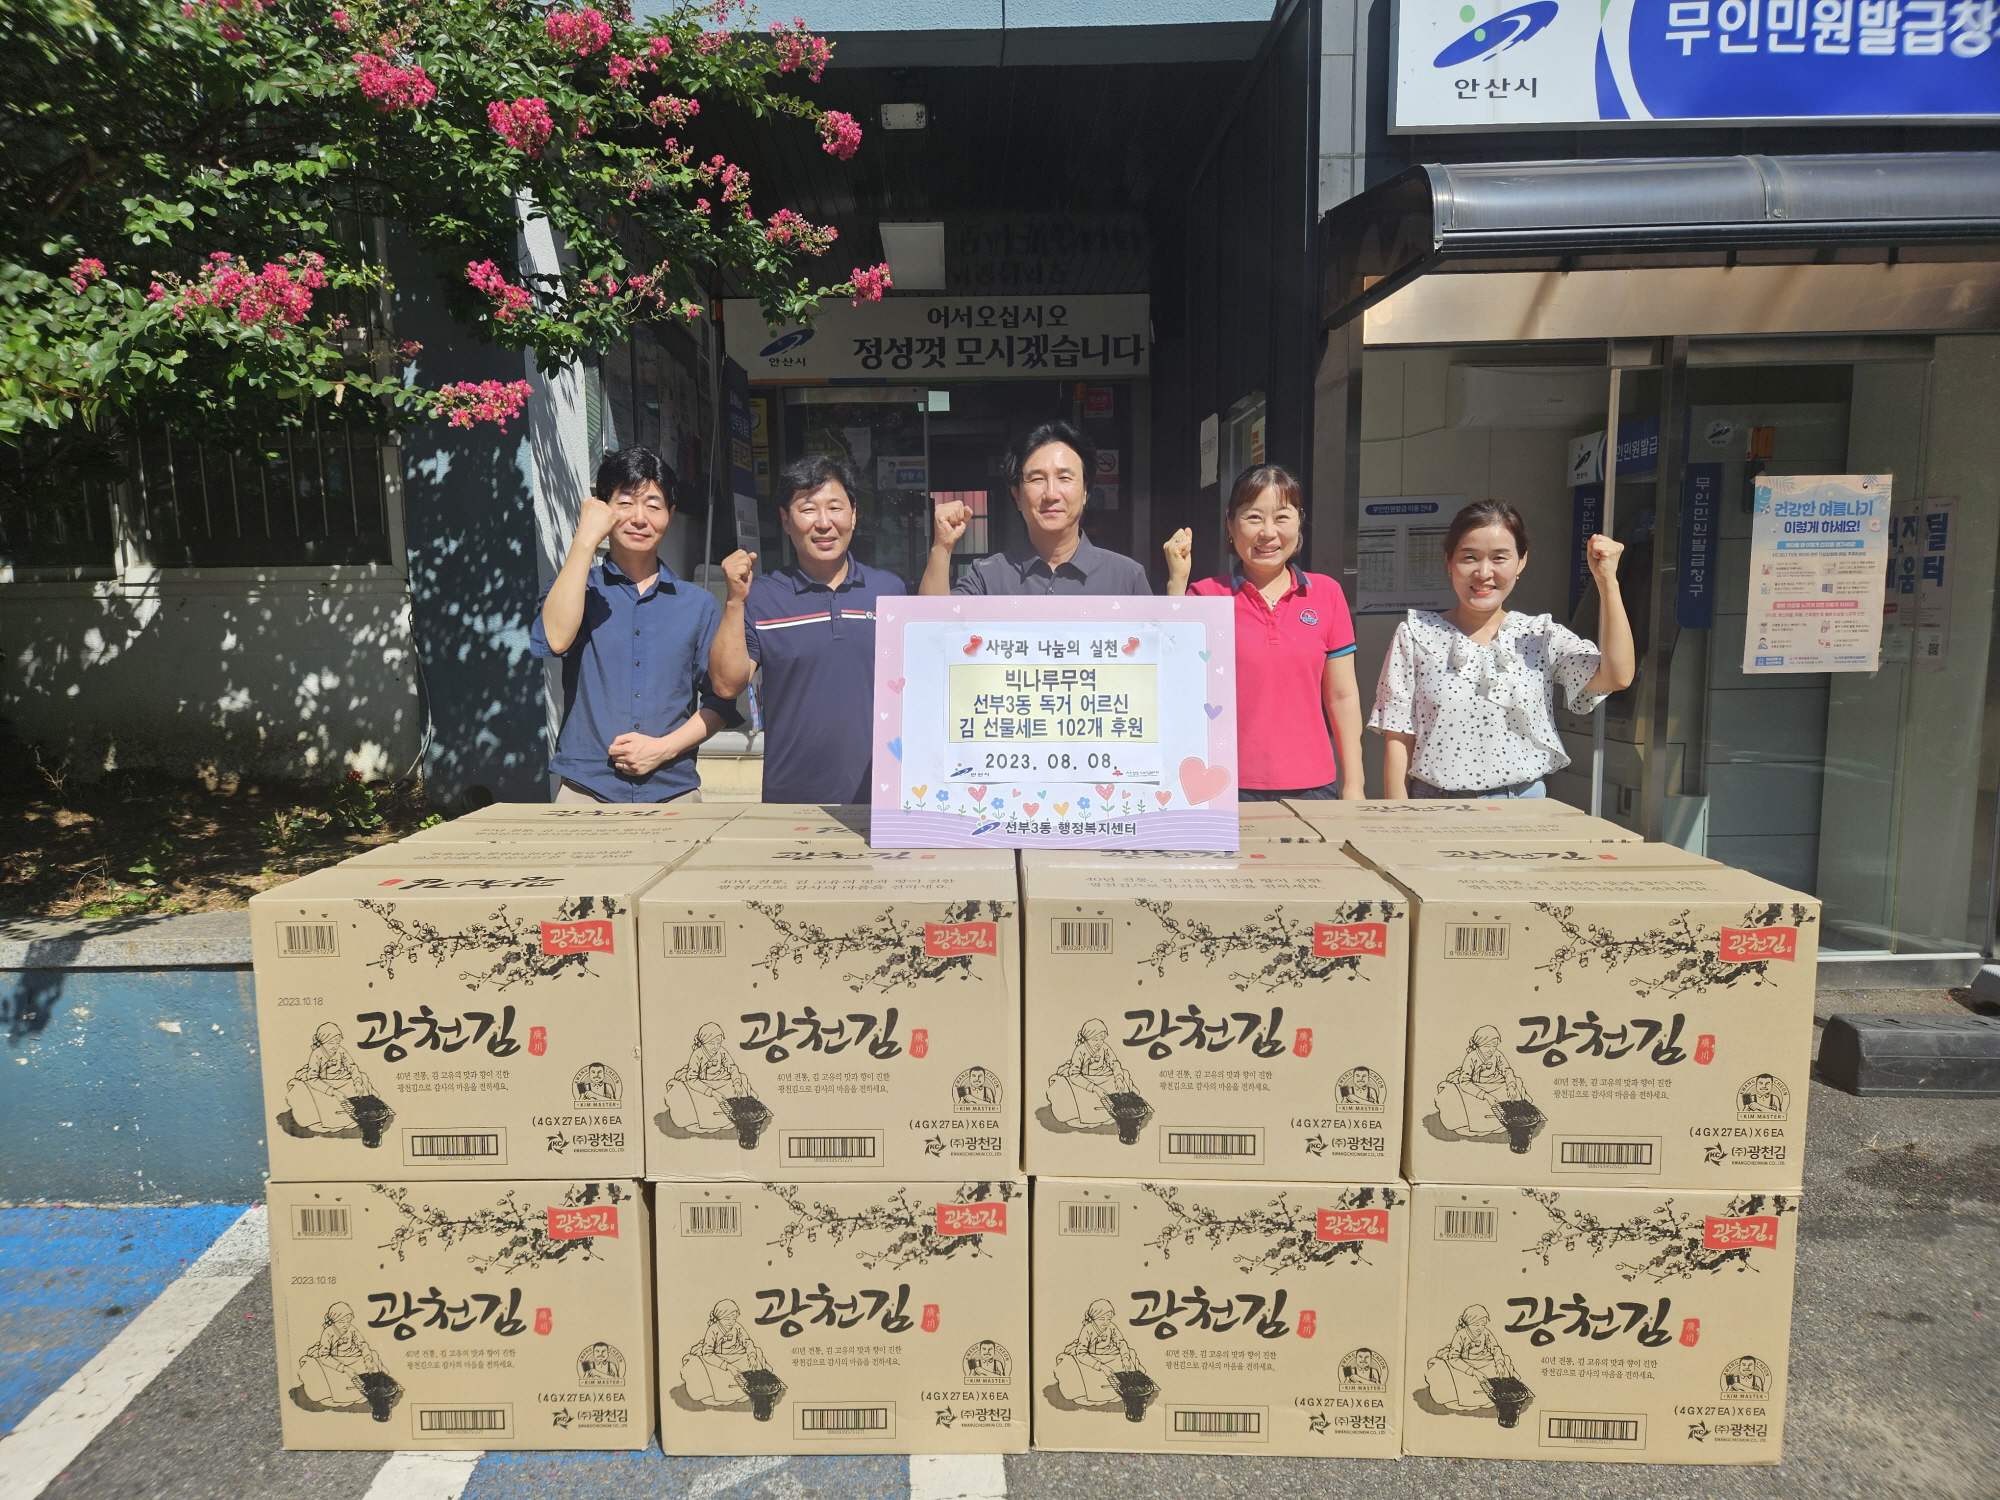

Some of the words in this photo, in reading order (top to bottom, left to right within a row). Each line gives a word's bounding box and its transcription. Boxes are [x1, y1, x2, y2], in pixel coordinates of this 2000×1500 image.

[1665, 0, 2000, 58] 무인민원발급창
[1454, 77, 1538, 100] 안산시
[927, 305, 1069, 329] 어서오십시오
[853, 335, 946, 371] 정성껏
[955, 333, 1145, 370] 모시겠습니다
[769, 357, 807, 368] 안산시
[1774, 500, 1816, 517] 건강한
[1819, 499, 1873, 517] 여름나기
[1784, 521, 1819, 533] 이렇게
[1821, 520, 1860, 533] 하세요!
[1689, 477, 1710, 597] 무인민원발급창구
[985, 639, 1029, 658] 사랑과
[1037, 639, 1081, 658] 나눔의
[1089, 640, 1118, 659] 실천
[1005, 668, 1097, 693] 빅나루무역
[973, 695, 1032, 715] 선부3동
[1039, 694, 1072, 715] 독거
[1081, 694, 1129, 715] 어르신
[959, 718, 974, 738] 김
[983, 718, 1048, 739] 선물세트
[1057, 718, 1103, 738] 102개
[1111, 717, 1144, 738] 후원
[985, 753, 1037, 770] 2023.
[1047, 753, 1077, 770] 08.
[1087, 753, 1119, 770] 08.
[1005, 820, 1052, 835] 선부3동
[1058, 821, 1137, 836] 행정복지센터
[547, 925, 602, 948] 광천김
[933, 928, 987, 950] 광천김
[1321, 928, 1376, 950] 광천김
[1728, 933, 1785, 955] 광천김
[278, 997, 323, 1006] 2023.10.18
[357, 1005, 521, 1062] 광천김
[739, 1007, 901, 1063] 광천김
[1122, 1004, 1285, 1060] 광천김
[1516, 1011, 1686, 1067] 광천김
[1159, 1070, 1174, 1079] 40년
[1177, 1070, 1192, 1079] 전통,
[1195, 1070, 1201, 1079] 김
[1203, 1071, 1224, 1079] 고유의
[1226, 1071, 1240, 1080] 맛과
[1243, 1071, 1256, 1080] 향이
[1259, 1071, 1273, 1080] 진한
[1554, 1078, 1568, 1086] 40년
[1572, 1078, 1587, 1086] 전통,
[1591, 1078, 1597, 1086] 김
[1624, 1079, 1638, 1087] 맛과
[1641, 1079, 1654, 1087] 향이
[1658, 1079, 1672, 1087] 진한
[1160, 1082, 1194, 1090] 광천김으로
[1196, 1083, 1216, 1091] 감사의
[1218, 1083, 1239, 1091] 마음을
[1241, 1083, 1271, 1091] 전하세요.
[1554, 1090, 1589, 1098] 광천김으로
[1592, 1091, 1612, 1099] 감사의
[1615, 1091, 1636, 1099] 마음을
[1639, 1091, 1669, 1099] 전하세요.
[573, 1132, 625, 1146] (주)광천김
[951, 1137, 1002, 1151] (주)광천김
[1332, 1137, 1384, 1150] (주)광천김
[1732, 1146, 1785, 1159] (주)광천김
[554, 1211, 607, 1232] 광천김
[944, 1207, 997, 1229] 광천김
[1324, 1214, 1378, 1235] 광천김
[1712, 1222, 1768, 1243] 광천김
[291, 1276, 337, 1286] 2023.10.18
[368, 1287, 527, 1341] 광천김
[754, 1283, 913, 1338] 광천김
[1128, 1286, 1289, 1340] 광천김
[1504, 1293, 1671, 1347] 광천김
[791, 1347, 805, 1356] 40년
[808, 1347, 823, 1355] 전통,
[826, 1347, 832, 1355] 김
[834, 1347, 855, 1355] 고유의
[857, 1347, 870, 1355] 맛과
[872, 1347, 885, 1355] 향이
[888, 1346, 902, 1355] 진한
[792, 1359, 826, 1367] 광천김으로
[827, 1359, 847, 1367] 감사의
[849, 1358, 869, 1367] 마음을
[871, 1358, 900, 1367] 전하세요.
[1541, 1356, 1556, 1365] 40년
[1559, 1357, 1574, 1365] 전통,
[1578, 1357, 1584, 1365] 김
[1586, 1358, 1608, 1366] 고유의
[1610, 1358, 1624, 1367] 맛과
[1626, 1359, 1640, 1367] 향이
[1643, 1359, 1657, 1367] 진한
[1541, 1368, 1576, 1376] 광천김으로
[1579, 1369, 1599, 1378] 감사의
[1601, 1370, 1622, 1378] 마음을
[1625, 1370, 1654, 1379] 전하세요.
[577, 1409, 627, 1422] (주)광천김
[961, 1408, 1011, 1421] (주)광천김
[1335, 1416, 1385, 1429] (주)광천김
[1715, 1424, 1767, 1437] (주)광천김
